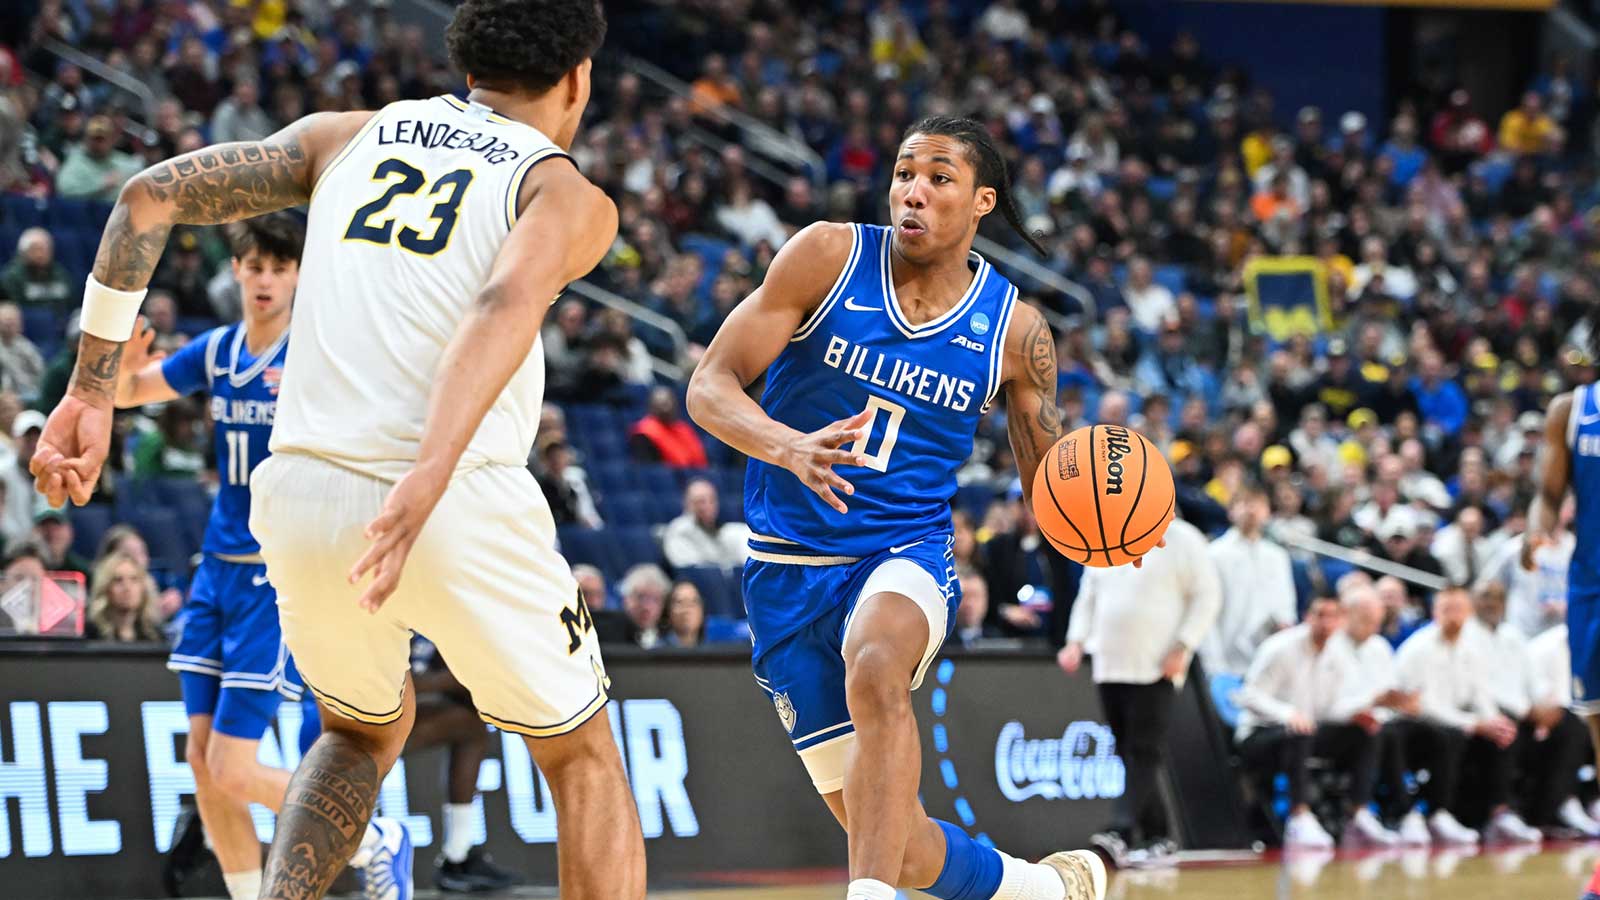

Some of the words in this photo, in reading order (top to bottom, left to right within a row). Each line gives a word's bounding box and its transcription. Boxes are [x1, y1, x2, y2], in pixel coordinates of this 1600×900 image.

[378, 120, 519, 165] LENDEBORG
[341, 157, 474, 257] 23
[824, 335, 976, 413] BILLIKENS
[226, 431, 249, 486] 11
[851, 394, 907, 474] 0
[1104, 427, 1131, 495] Wilson
[559, 584, 594, 657] M
